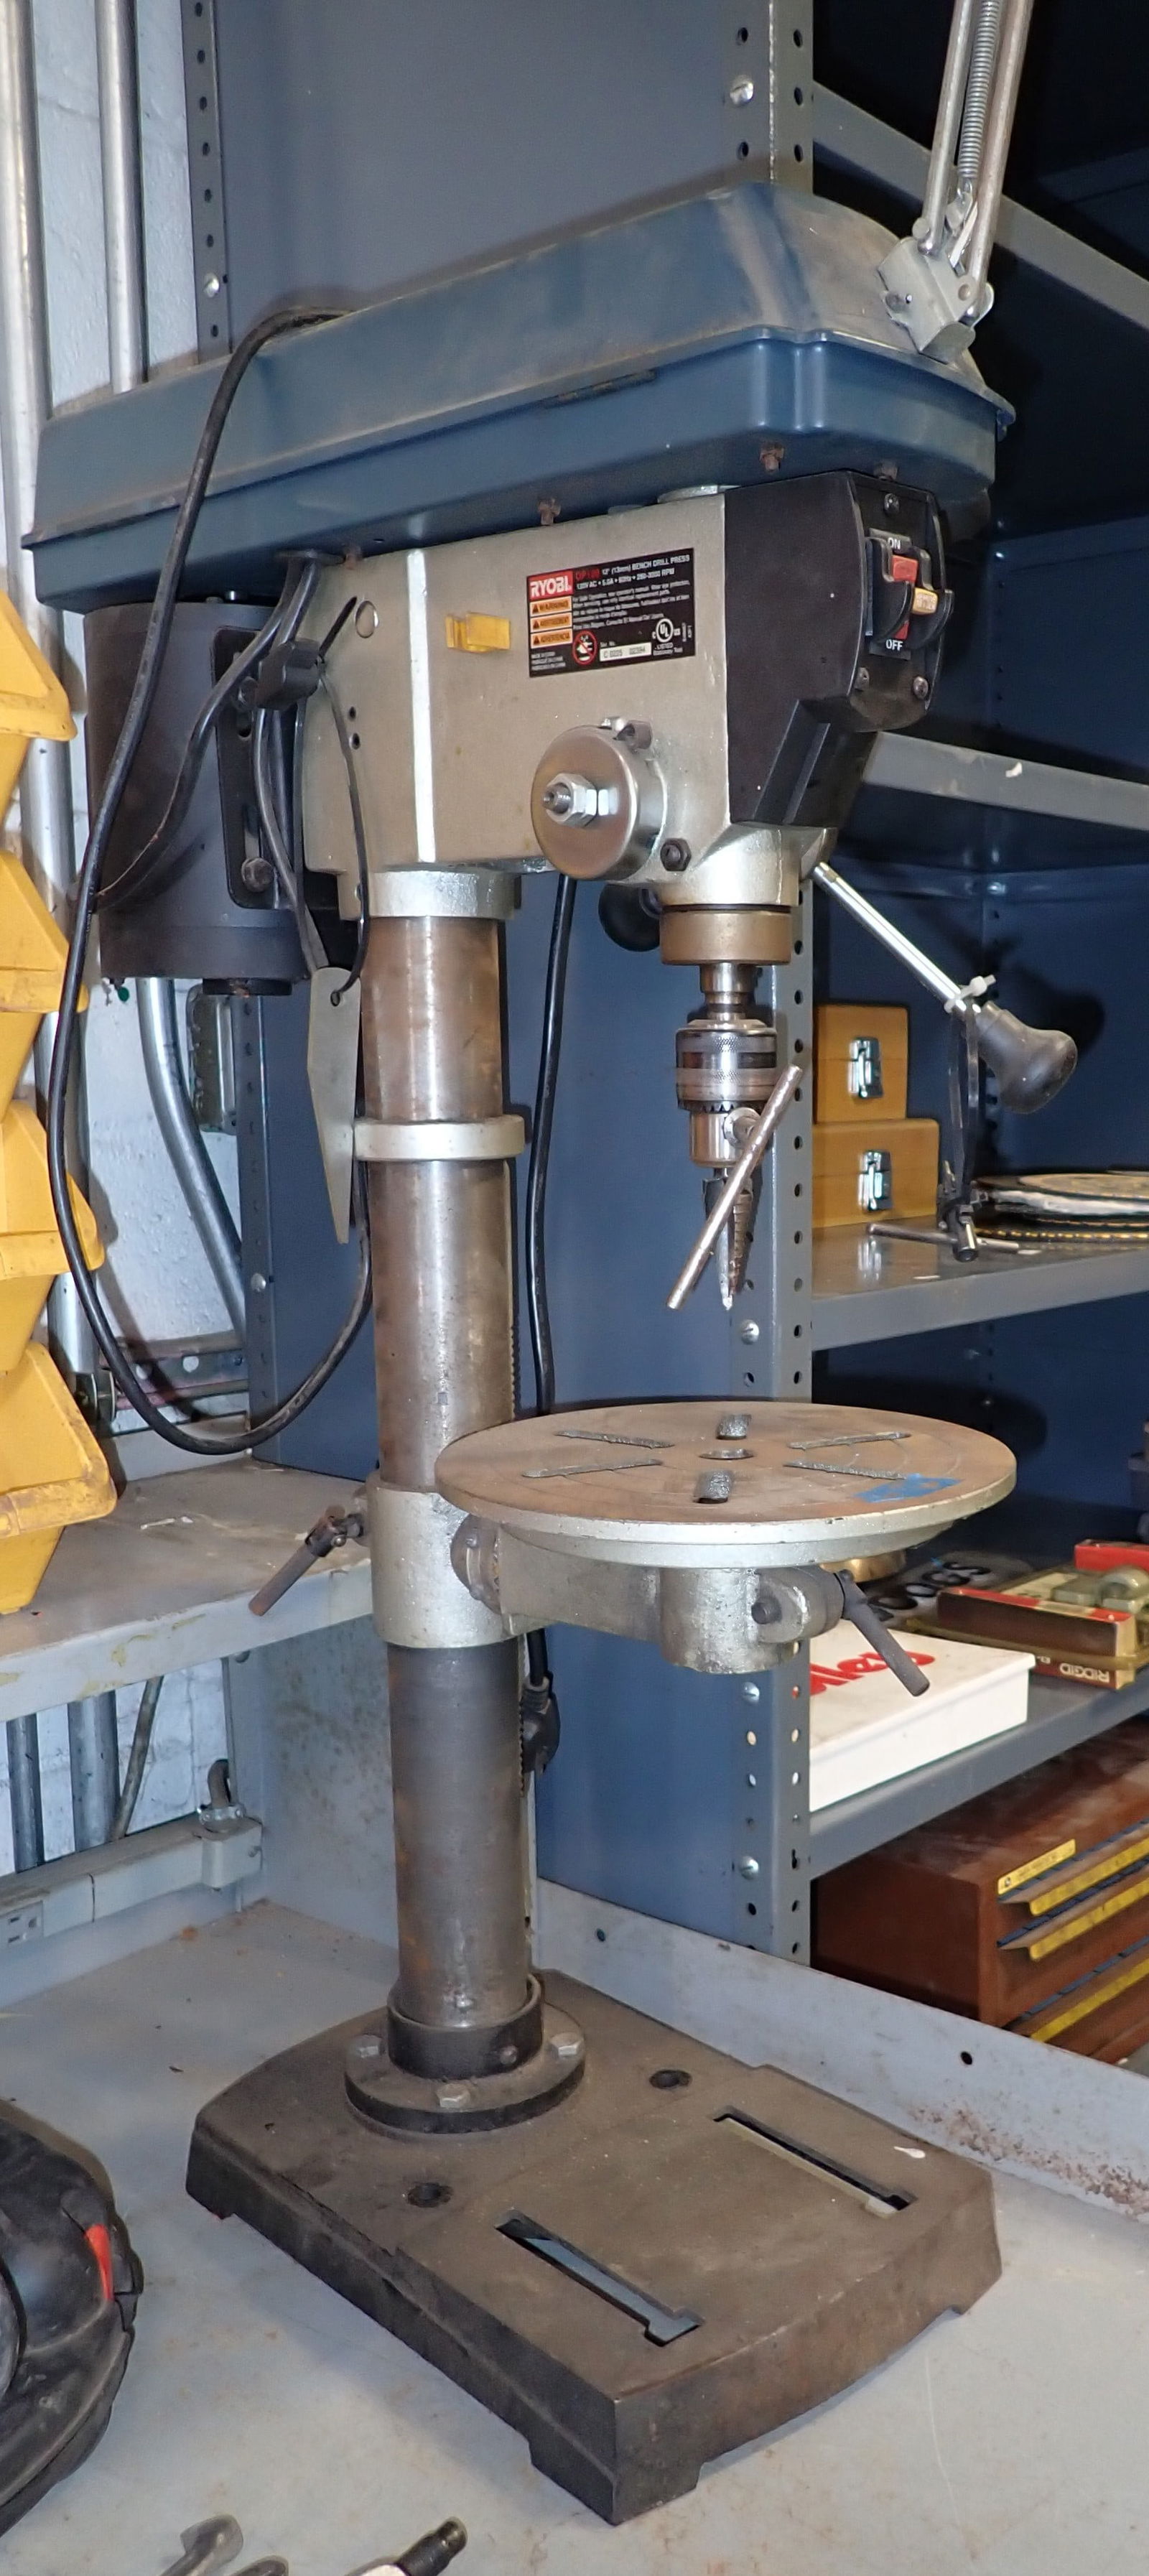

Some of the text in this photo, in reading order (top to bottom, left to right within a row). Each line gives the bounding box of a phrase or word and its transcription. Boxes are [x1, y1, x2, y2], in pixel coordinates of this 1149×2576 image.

[888, 538, 901, 549] ON
[632, 561, 652, 571] BENCH
[653, 558, 669, 567] DRILL
[670, 554, 690, 564] PRESS
[530, 575, 570, 597] RYOBI
[886, 639, 903, 651] OFF
[1060, 1663, 1110, 1683] RIDGID
